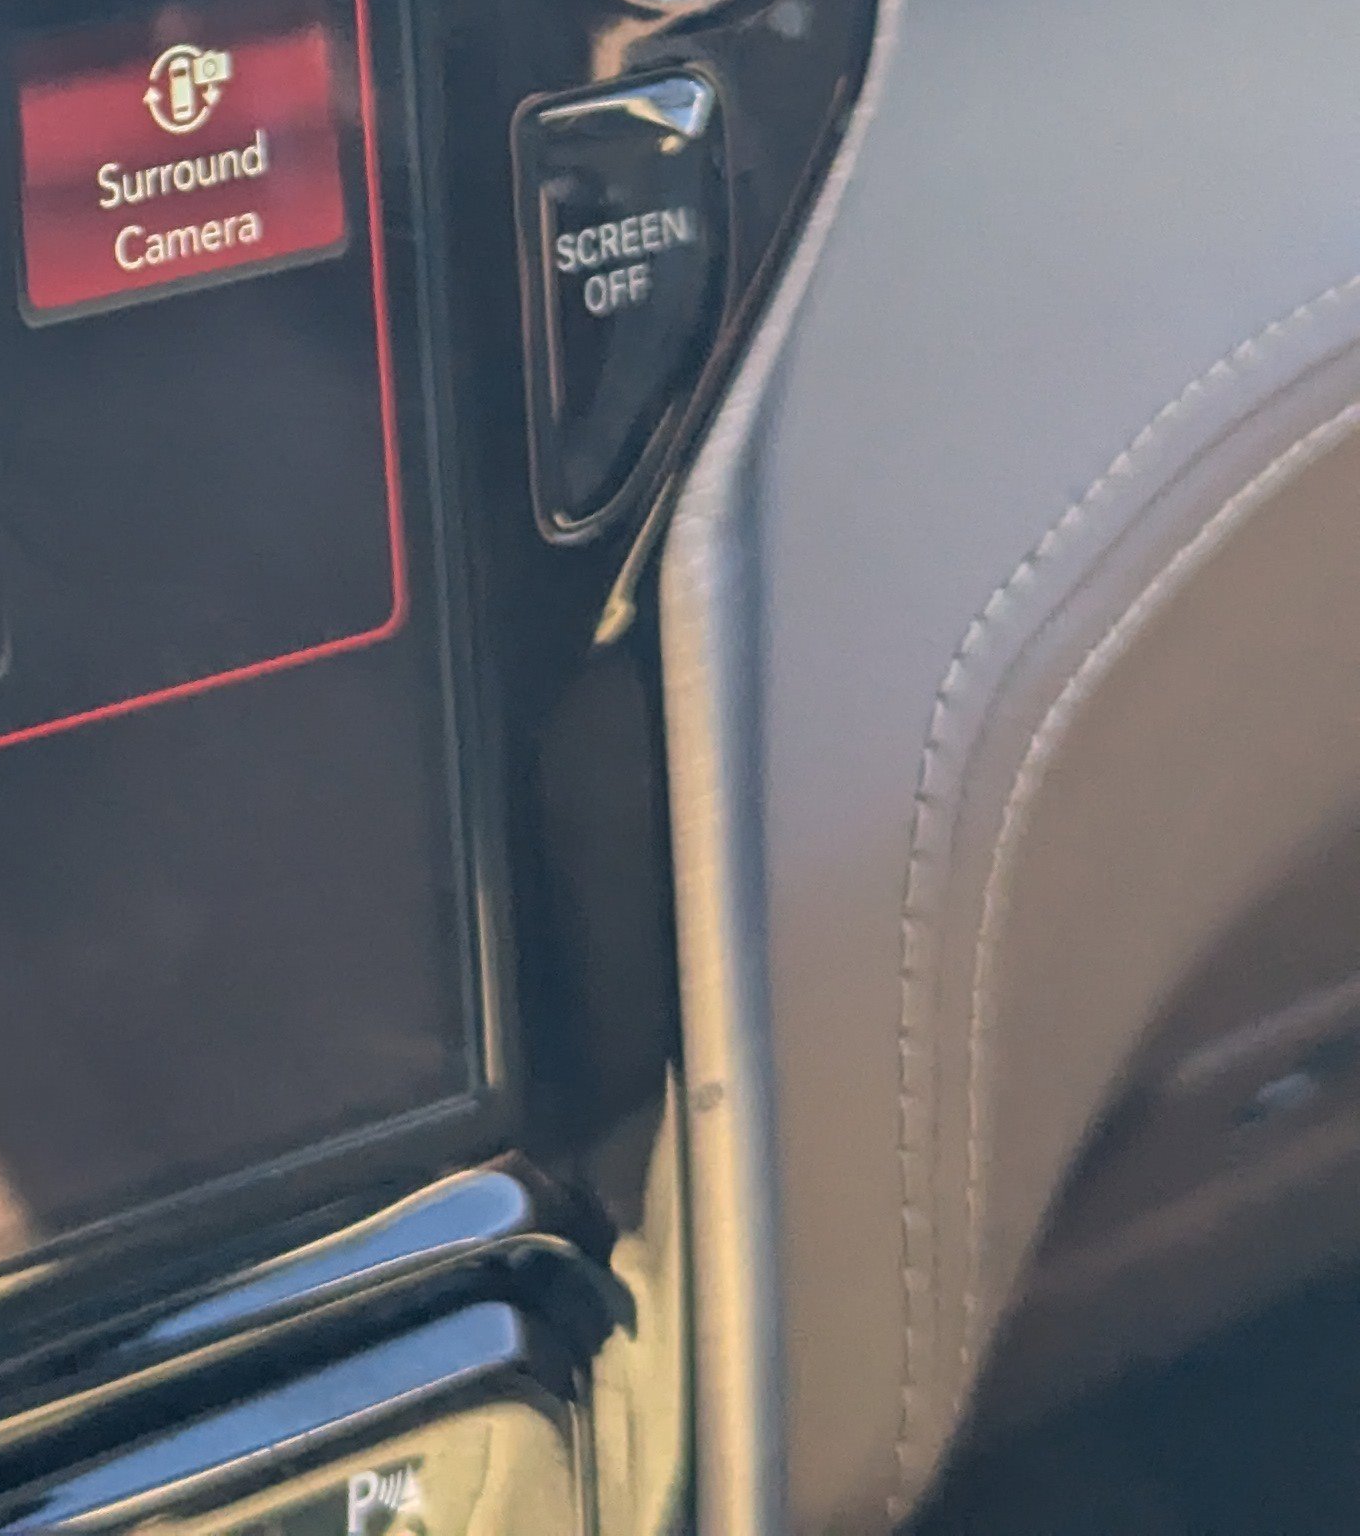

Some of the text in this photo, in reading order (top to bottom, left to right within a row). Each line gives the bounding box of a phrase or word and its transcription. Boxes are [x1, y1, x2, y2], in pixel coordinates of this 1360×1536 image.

[97, 130, 267, 211] Surround
[114, 208, 263, 272] Camera
[555, 206, 694, 273] SCREEN
[583, 263, 651, 316] OFF
